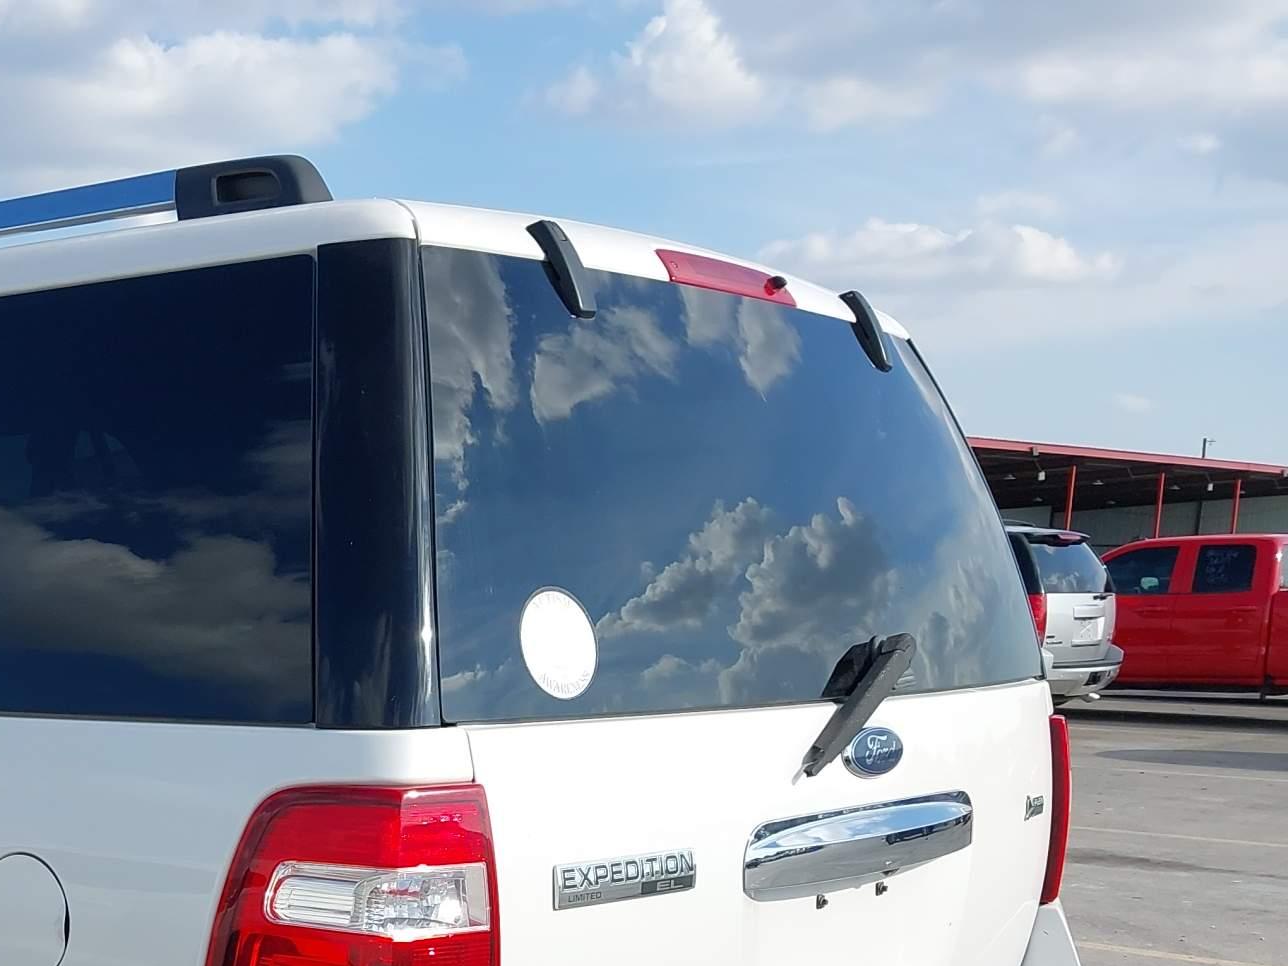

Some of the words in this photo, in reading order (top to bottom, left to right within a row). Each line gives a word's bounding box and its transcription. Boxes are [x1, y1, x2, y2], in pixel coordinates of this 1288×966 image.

[865, 734, 897, 765] Ford
[562, 851, 694, 889] EXPEDITION
[656, 879, 684, 891] EL
[567, 891, 602, 903] LIMITED
